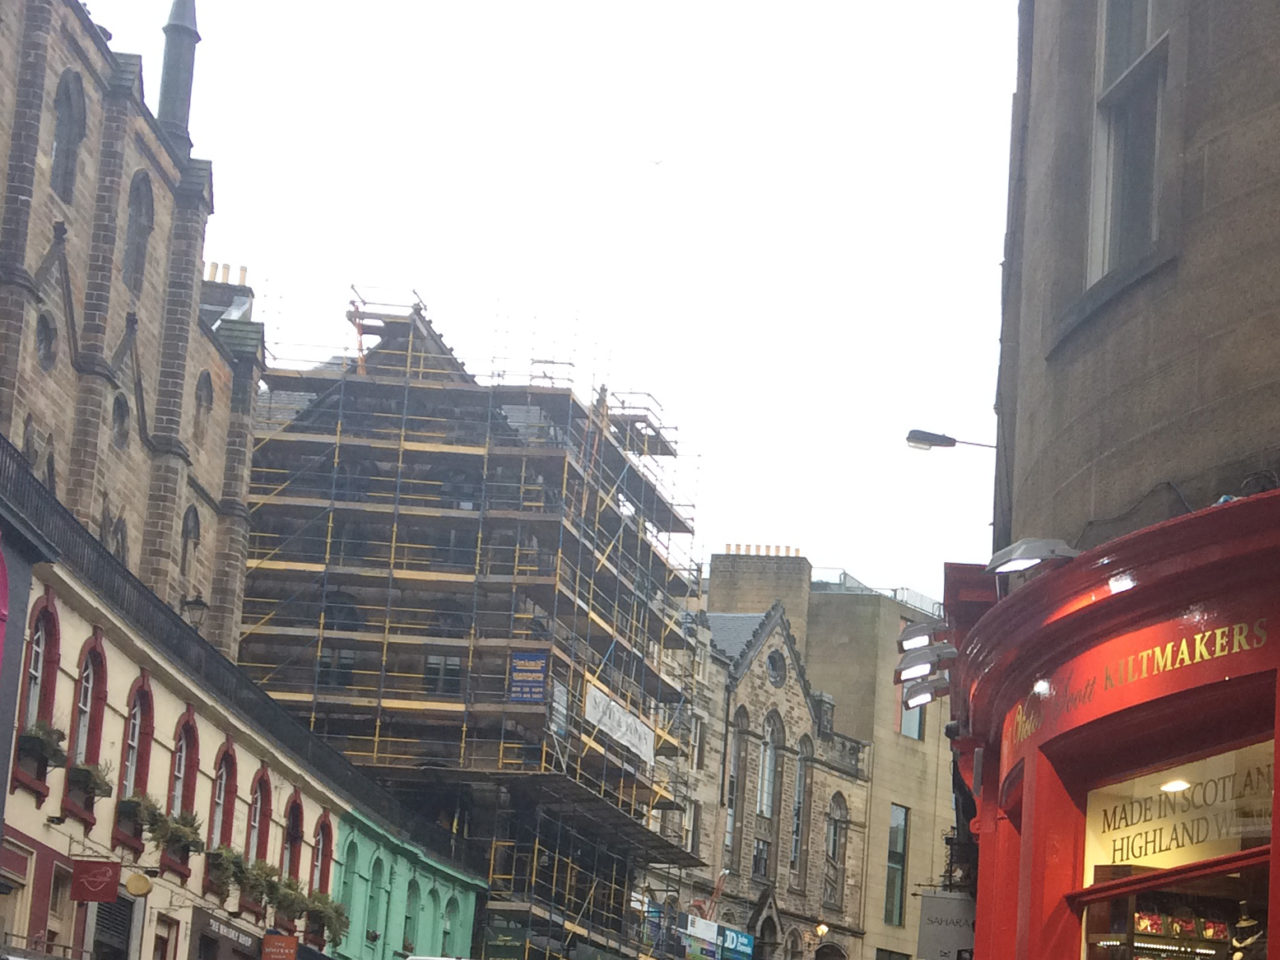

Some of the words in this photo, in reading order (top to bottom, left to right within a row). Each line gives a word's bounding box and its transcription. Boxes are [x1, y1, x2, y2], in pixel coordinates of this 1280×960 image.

[1103, 617, 1268, 692] KILTMAKERS
[1102, 796, 1153, 834] MADE
[1157, 791, 1177, 820] IN
[1181, 762, 1274, 814] SCOTLAN
[1111, 815, 1209, 865] HIGHLAND
